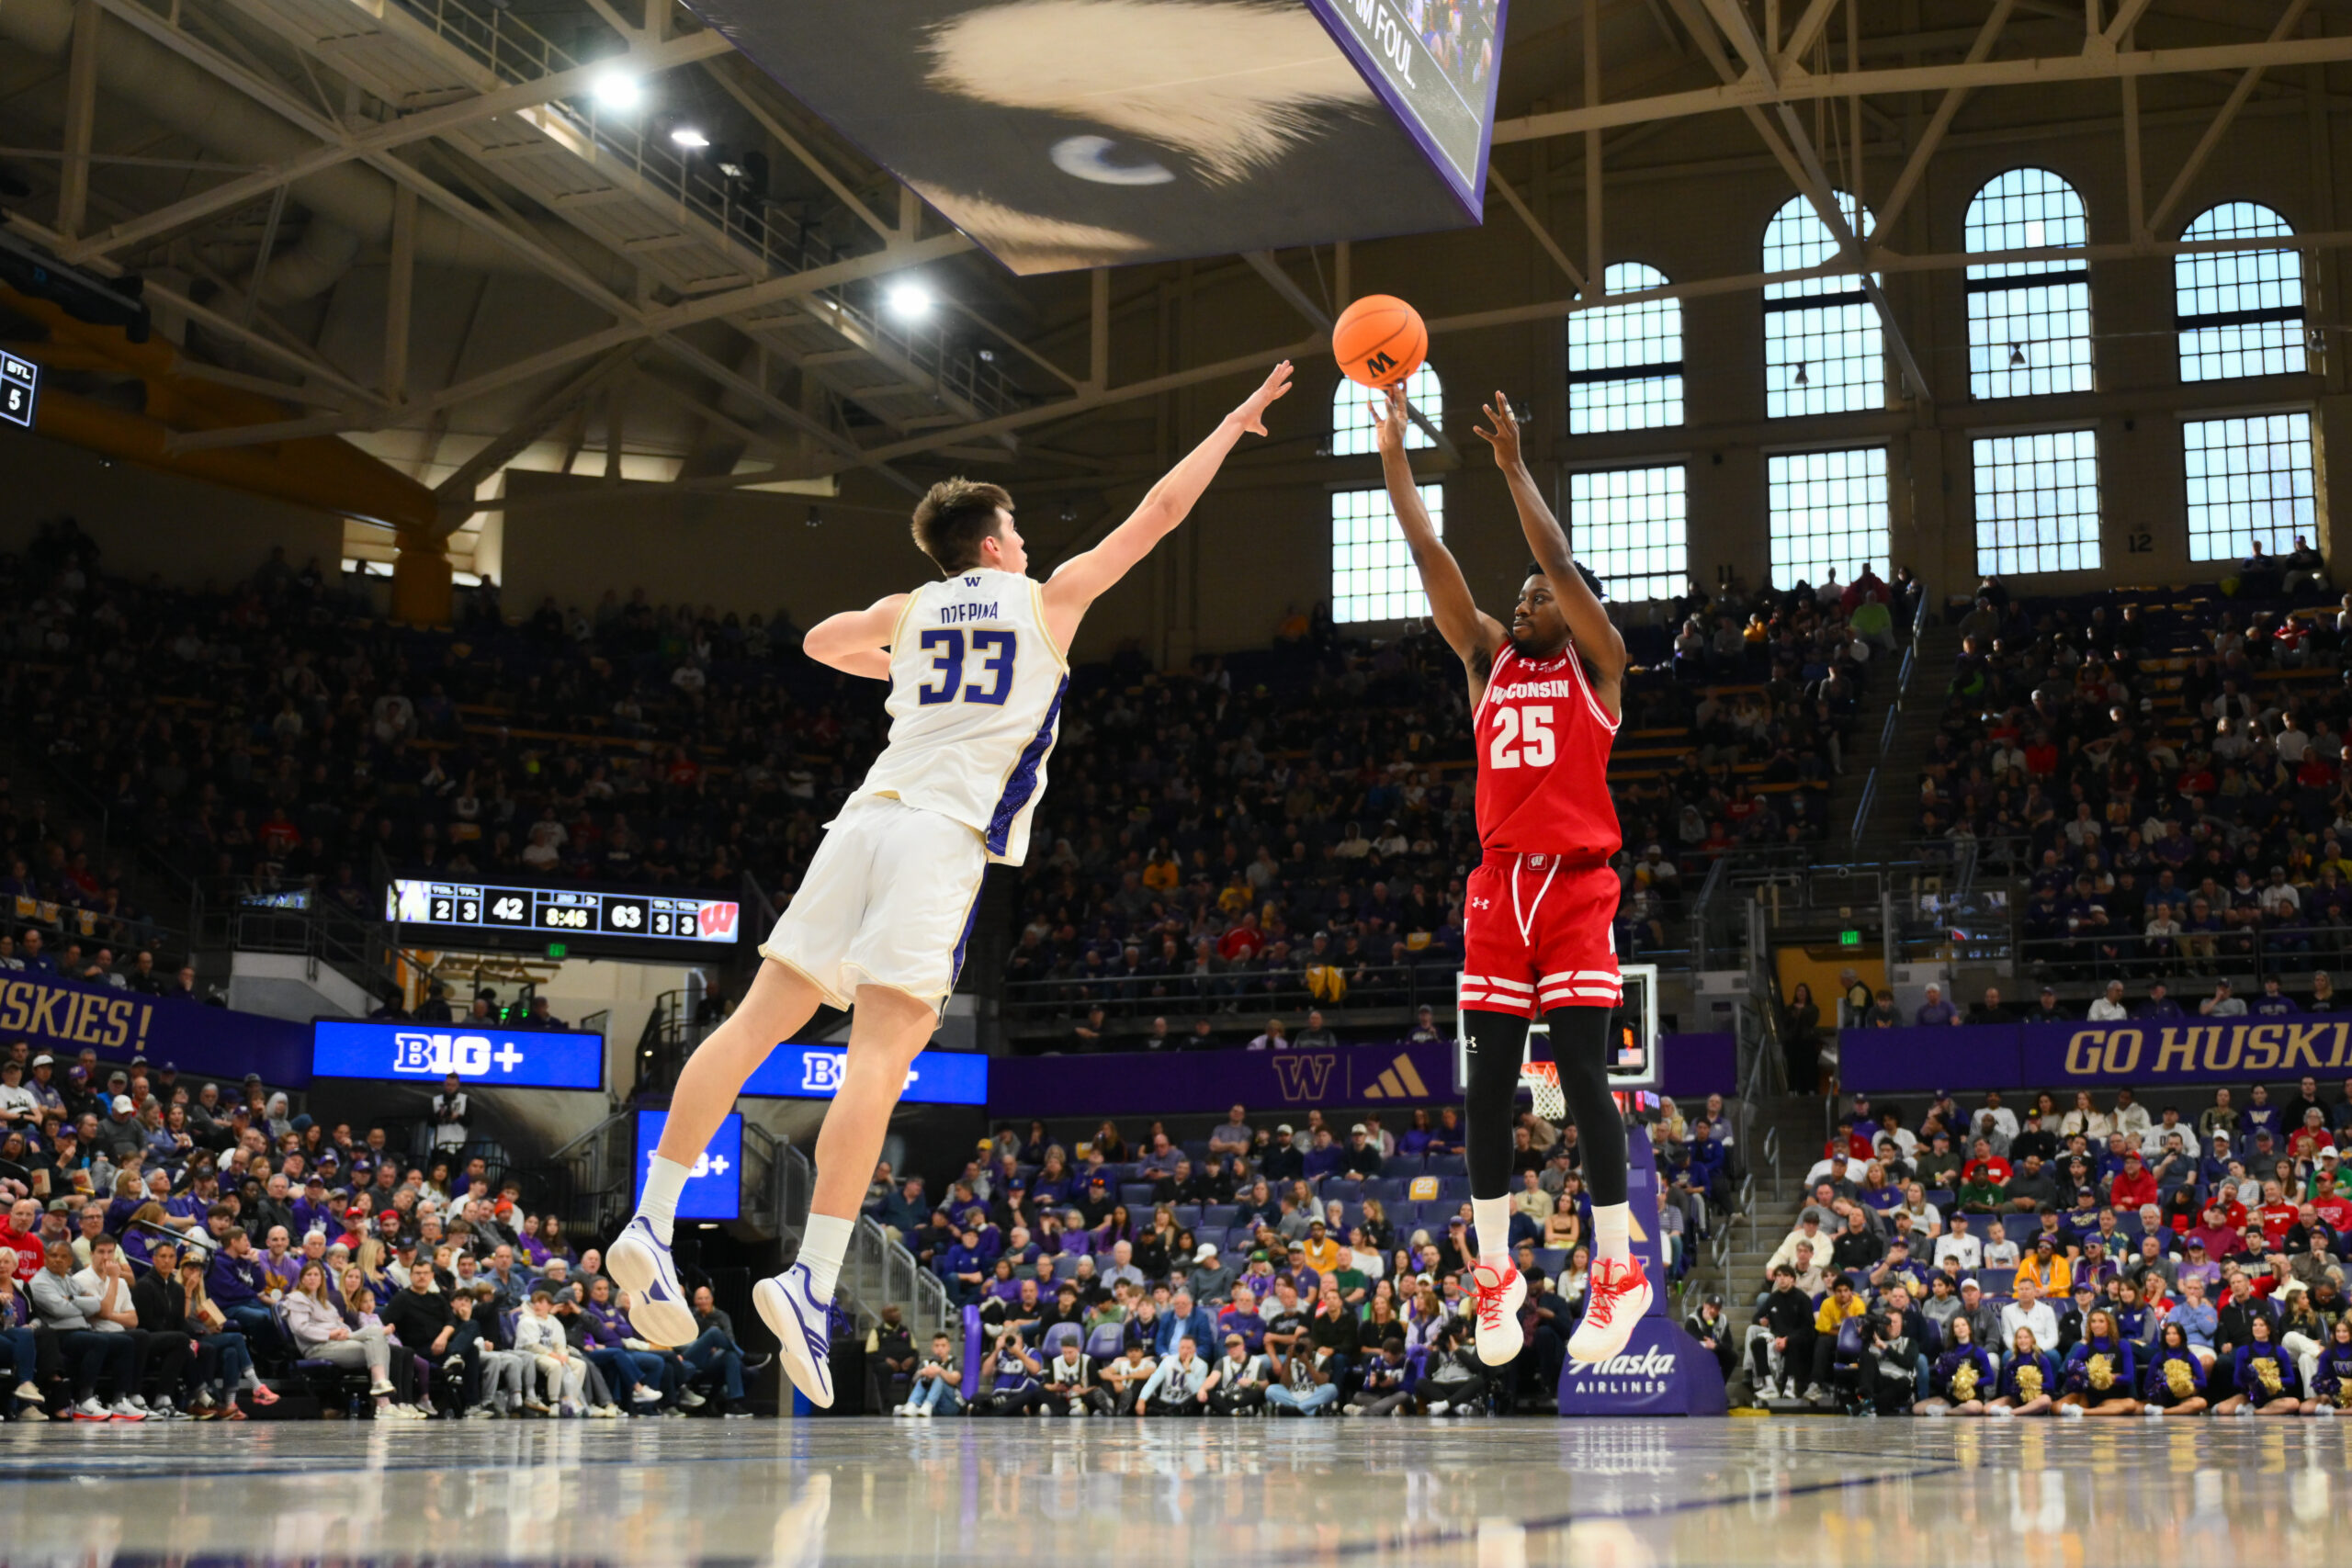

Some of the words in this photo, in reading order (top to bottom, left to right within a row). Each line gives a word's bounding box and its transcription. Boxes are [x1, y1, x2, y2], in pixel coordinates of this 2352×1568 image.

[8, 389, 21, 411] 5
[2129, 534, 2153, 553] 12
[964, 576, 982, 588] W
[919, 627, 1019, 708] 33
[1489, 680, 1569, 705] WCONSIN
[1489, 705, 1556, 770] 25
[435, 900, 450, 919] 2
[463, 902, 477, 920] 3
[492, 897, 524, 920] 42
[546, 908, 588, 928] 8:46
[611, 905, 641, 929] 63
[655, 914, 670, 933] 3
[681, 916, 695, 934] 3
[2064, 1029, 2143, 1075] GO
[2152, 1022, 2352, 1072] HUSKI
[1272, 1055, 1336, 1100] W
[1575, 1381, 1667, 1393] AIRLINES
